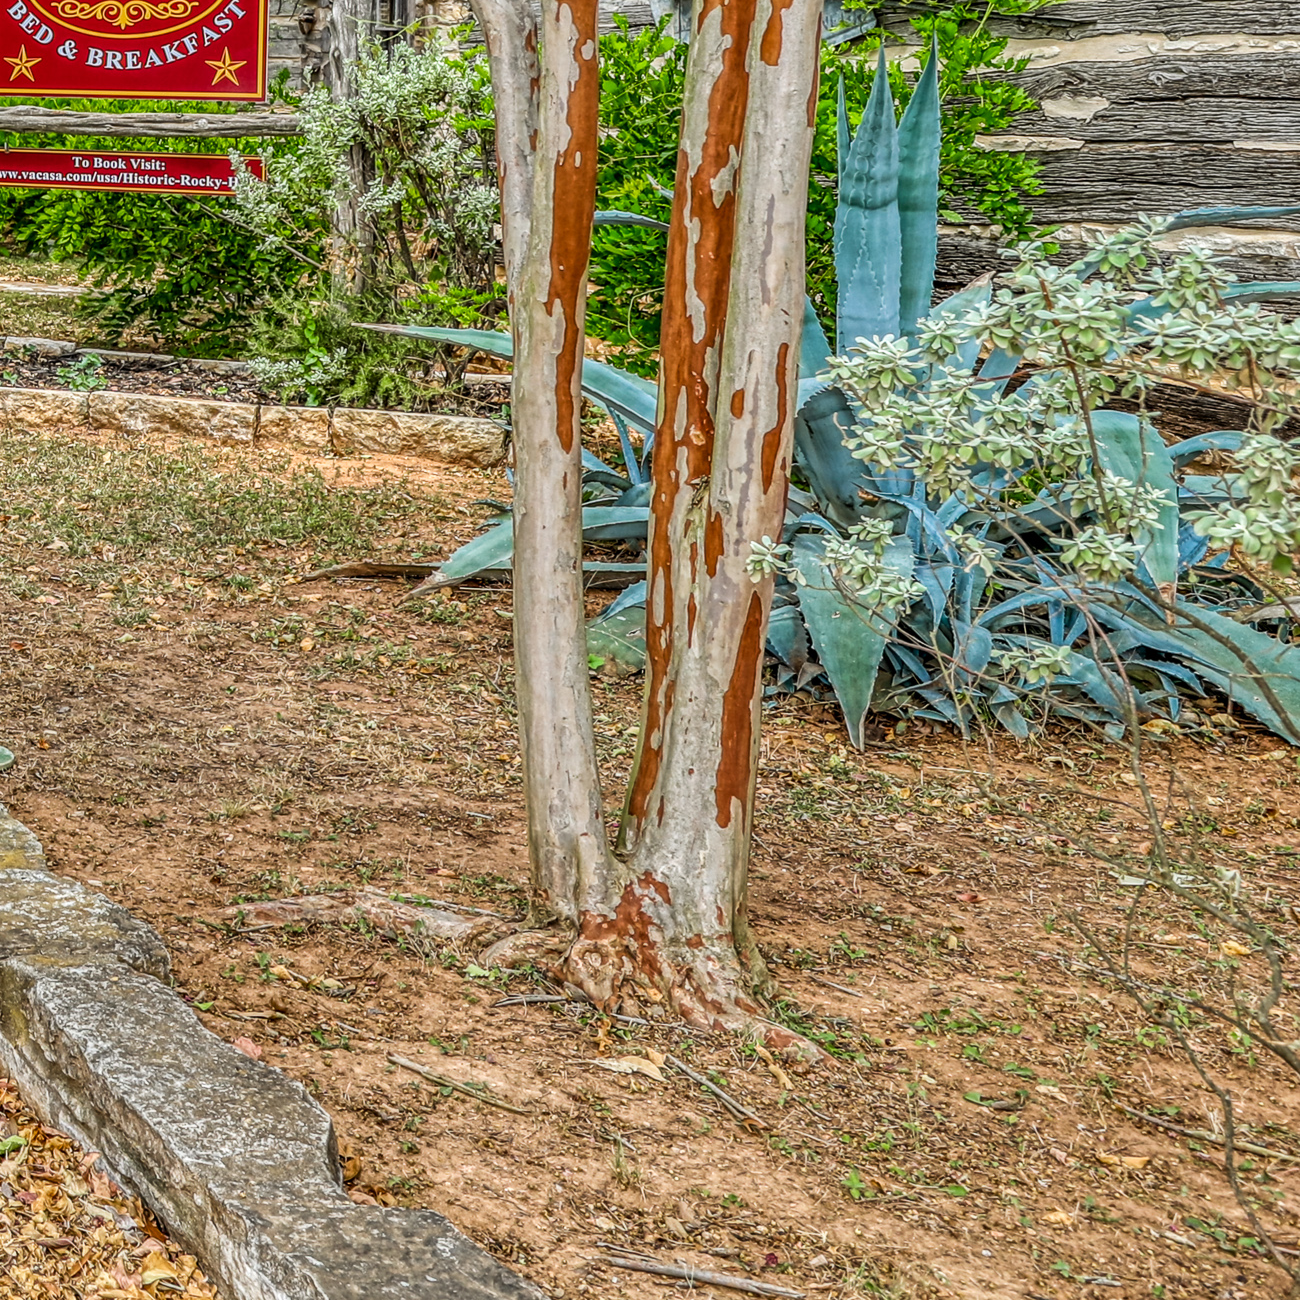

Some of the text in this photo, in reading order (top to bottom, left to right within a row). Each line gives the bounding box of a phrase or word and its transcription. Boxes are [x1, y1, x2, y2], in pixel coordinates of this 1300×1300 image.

[6, 0, 55, 45] BED
[57, 40, 78, 60] &
[71, 156, 166, 171] To Book Visit:
